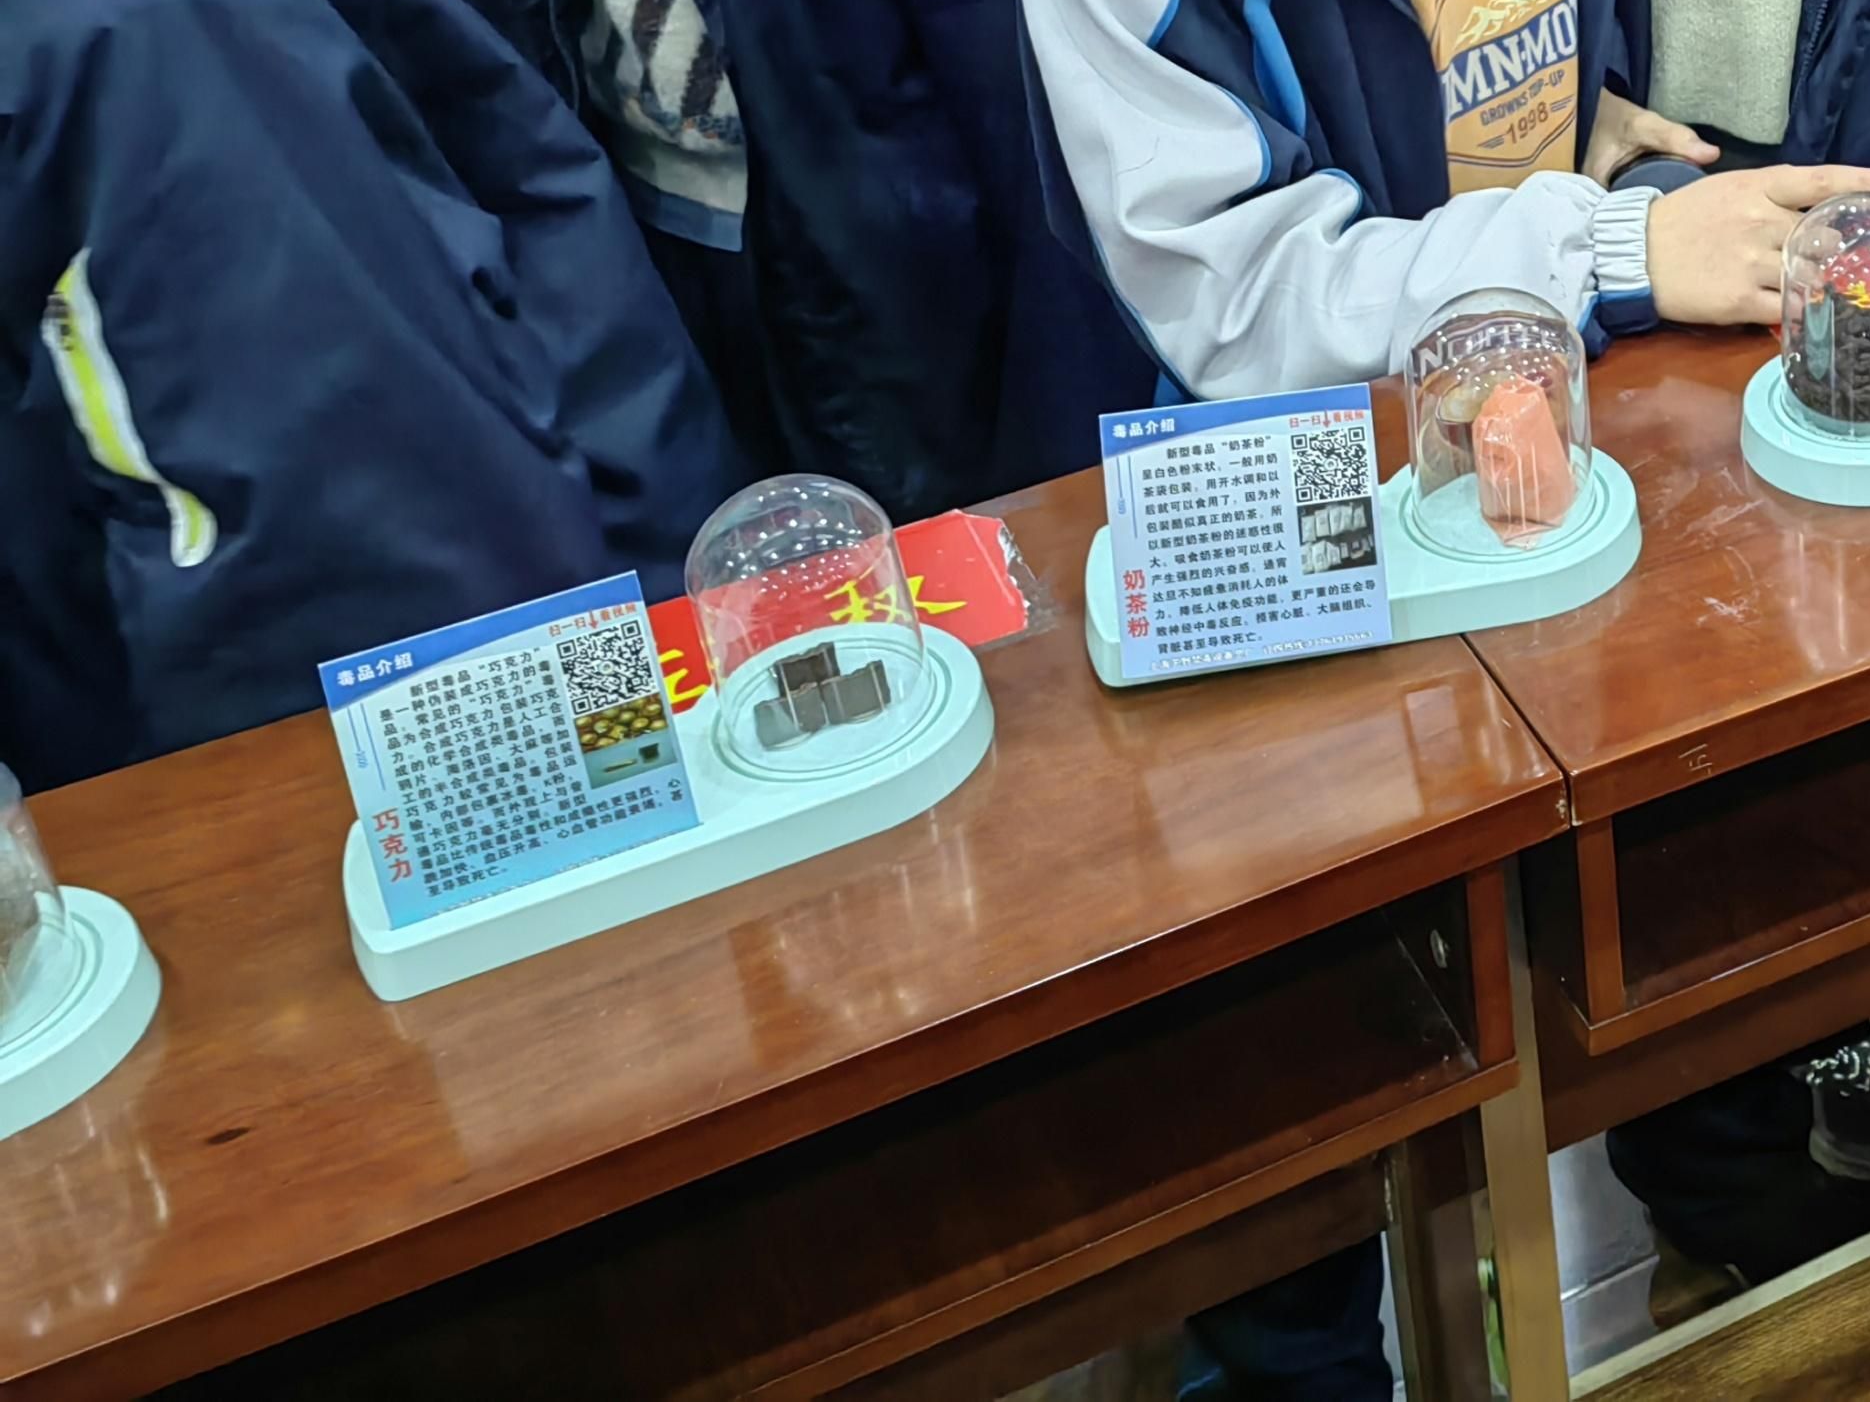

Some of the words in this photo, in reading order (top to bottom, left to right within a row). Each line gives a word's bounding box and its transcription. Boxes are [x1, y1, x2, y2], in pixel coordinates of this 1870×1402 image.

[1505, 101, 1549, 144] 1998
[1111, 417, 1176, 440] 毒品介绍
[1121, 567, 1150, 639] 奶茶粉
[335, 650, 414, 689] 毒品介绍
[371, 805, 416, 885] 巧克力
